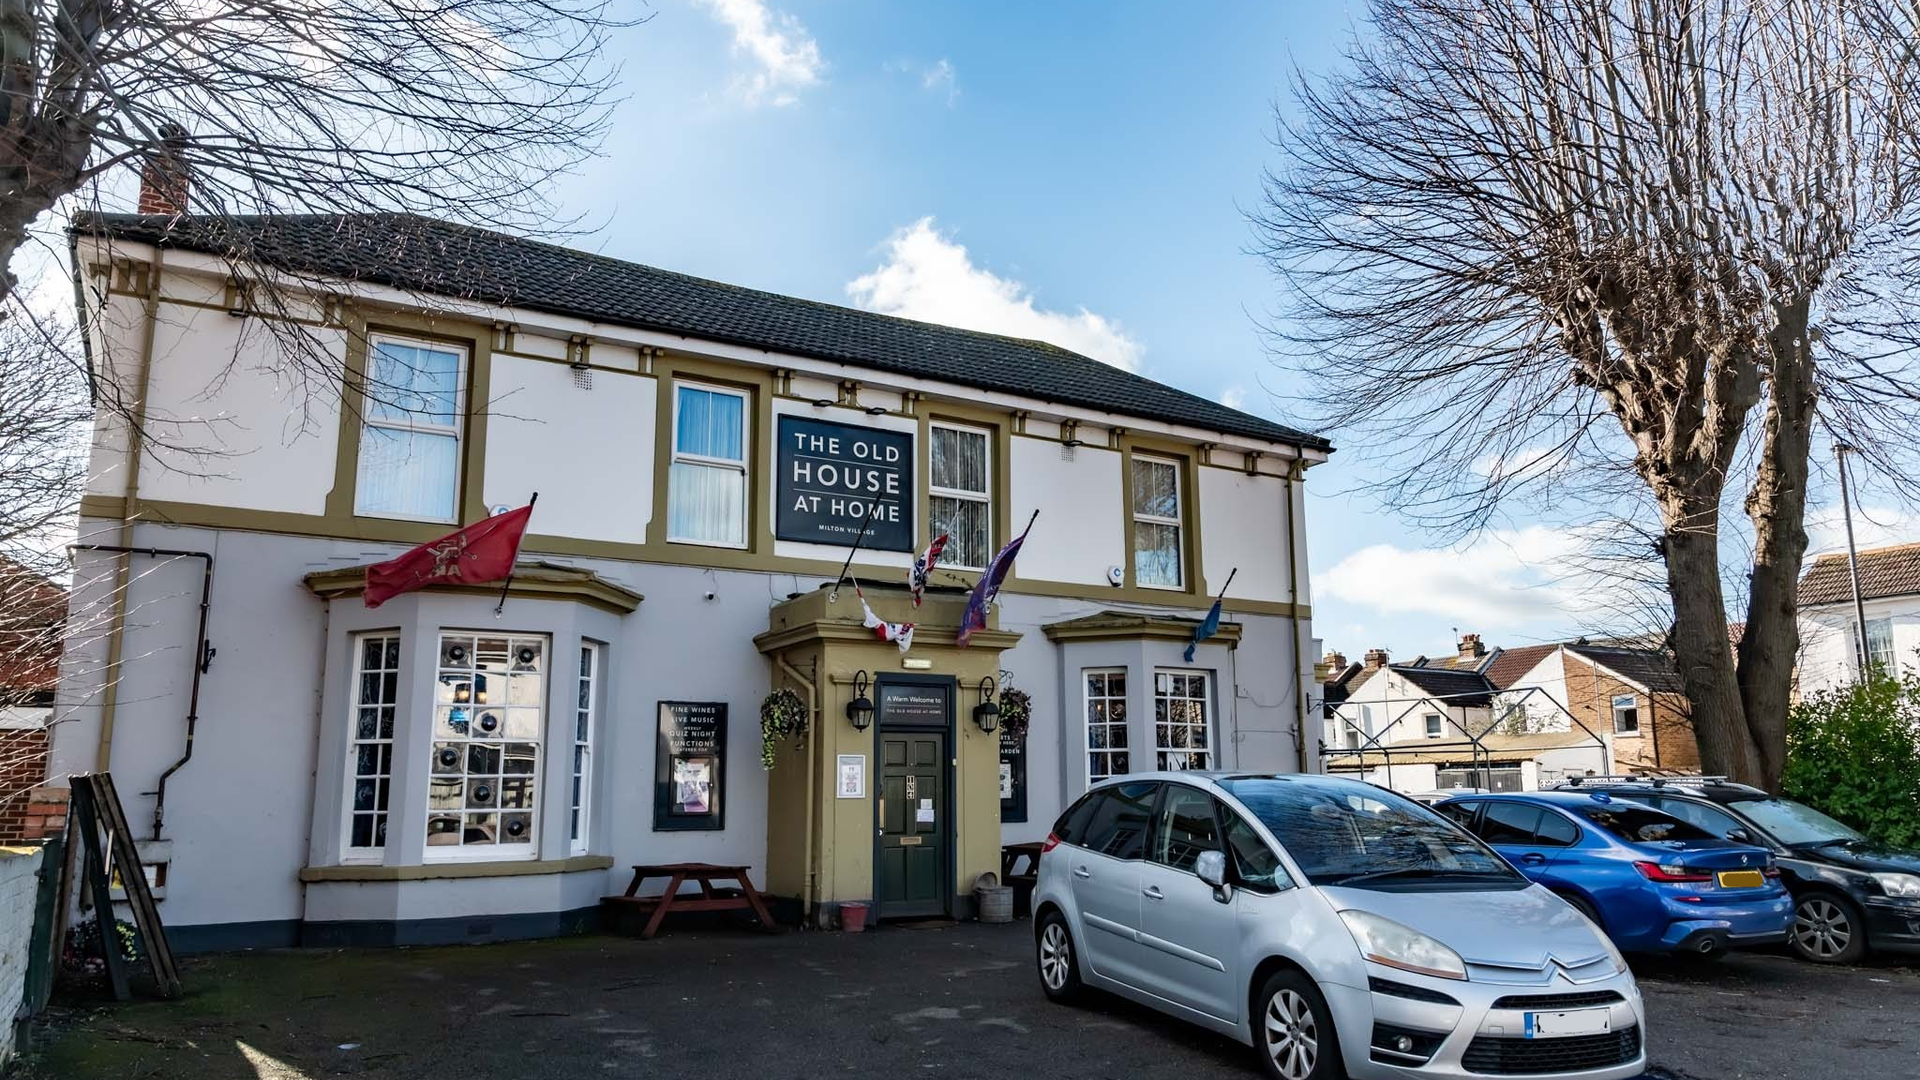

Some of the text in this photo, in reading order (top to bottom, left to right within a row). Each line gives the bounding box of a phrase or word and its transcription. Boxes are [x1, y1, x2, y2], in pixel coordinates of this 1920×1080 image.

[794, 432, 899, 462] THE OLD
[793, 460, 900, 494] HOUSE
[793, 495, 900, 522] AT HOME
[818, 524, 845, 532] MILTON
